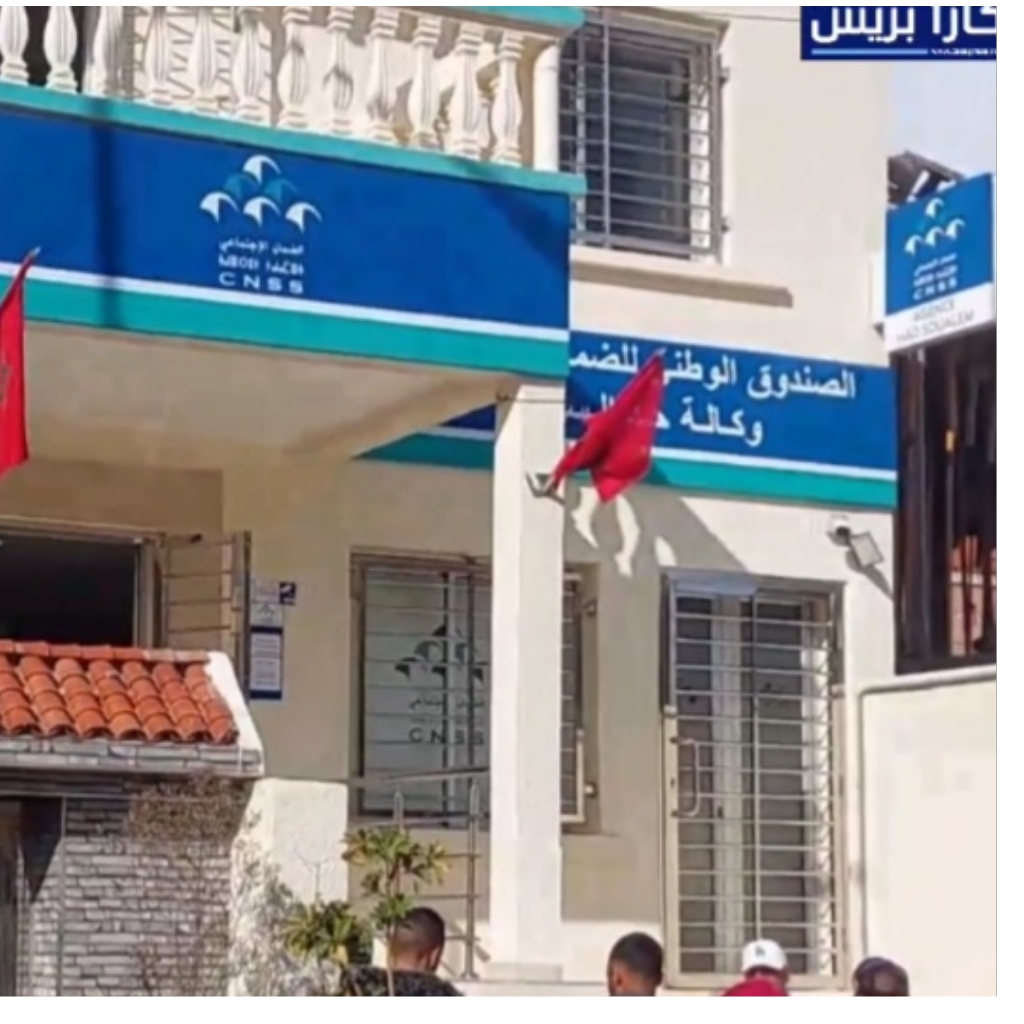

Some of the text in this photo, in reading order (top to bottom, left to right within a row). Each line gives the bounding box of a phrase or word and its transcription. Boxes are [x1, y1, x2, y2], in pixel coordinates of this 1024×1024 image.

[219, 272, 304, 294] CNSS
[746, 363, 857, 400] الصندوق
[679, 396, 764, 447] وكالة
